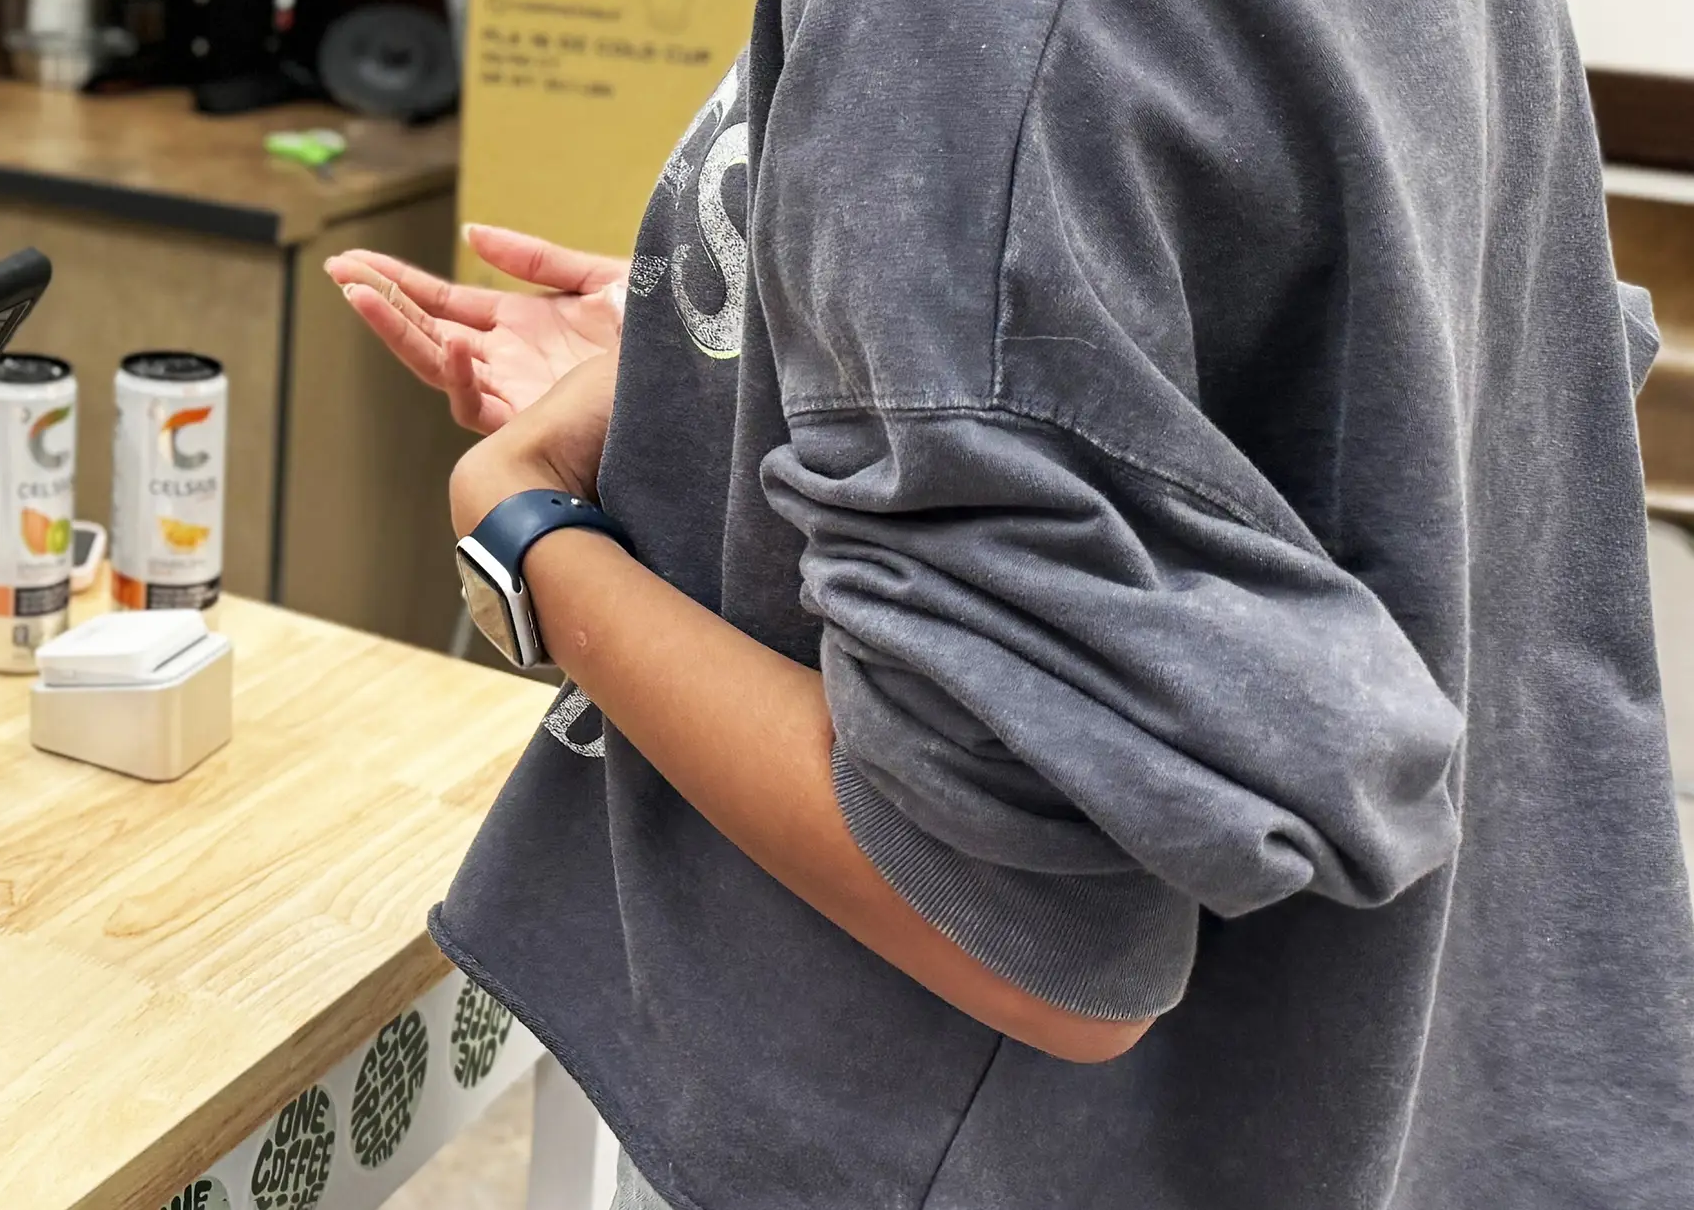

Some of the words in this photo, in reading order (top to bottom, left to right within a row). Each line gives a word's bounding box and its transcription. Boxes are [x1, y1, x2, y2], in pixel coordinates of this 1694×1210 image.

[18, 473, 75, 500] CELS
[376, 1013, 412, 1158] COFFEE
[399, 1010, 430, 1103] ONE
[455, 1037, 496, 1089] ONE
[275, 1084, 330, 1147] ONE
[351, 1046, 388, 1169] CIRCLE
[251, 1130, 335, 1195] COFFEE
